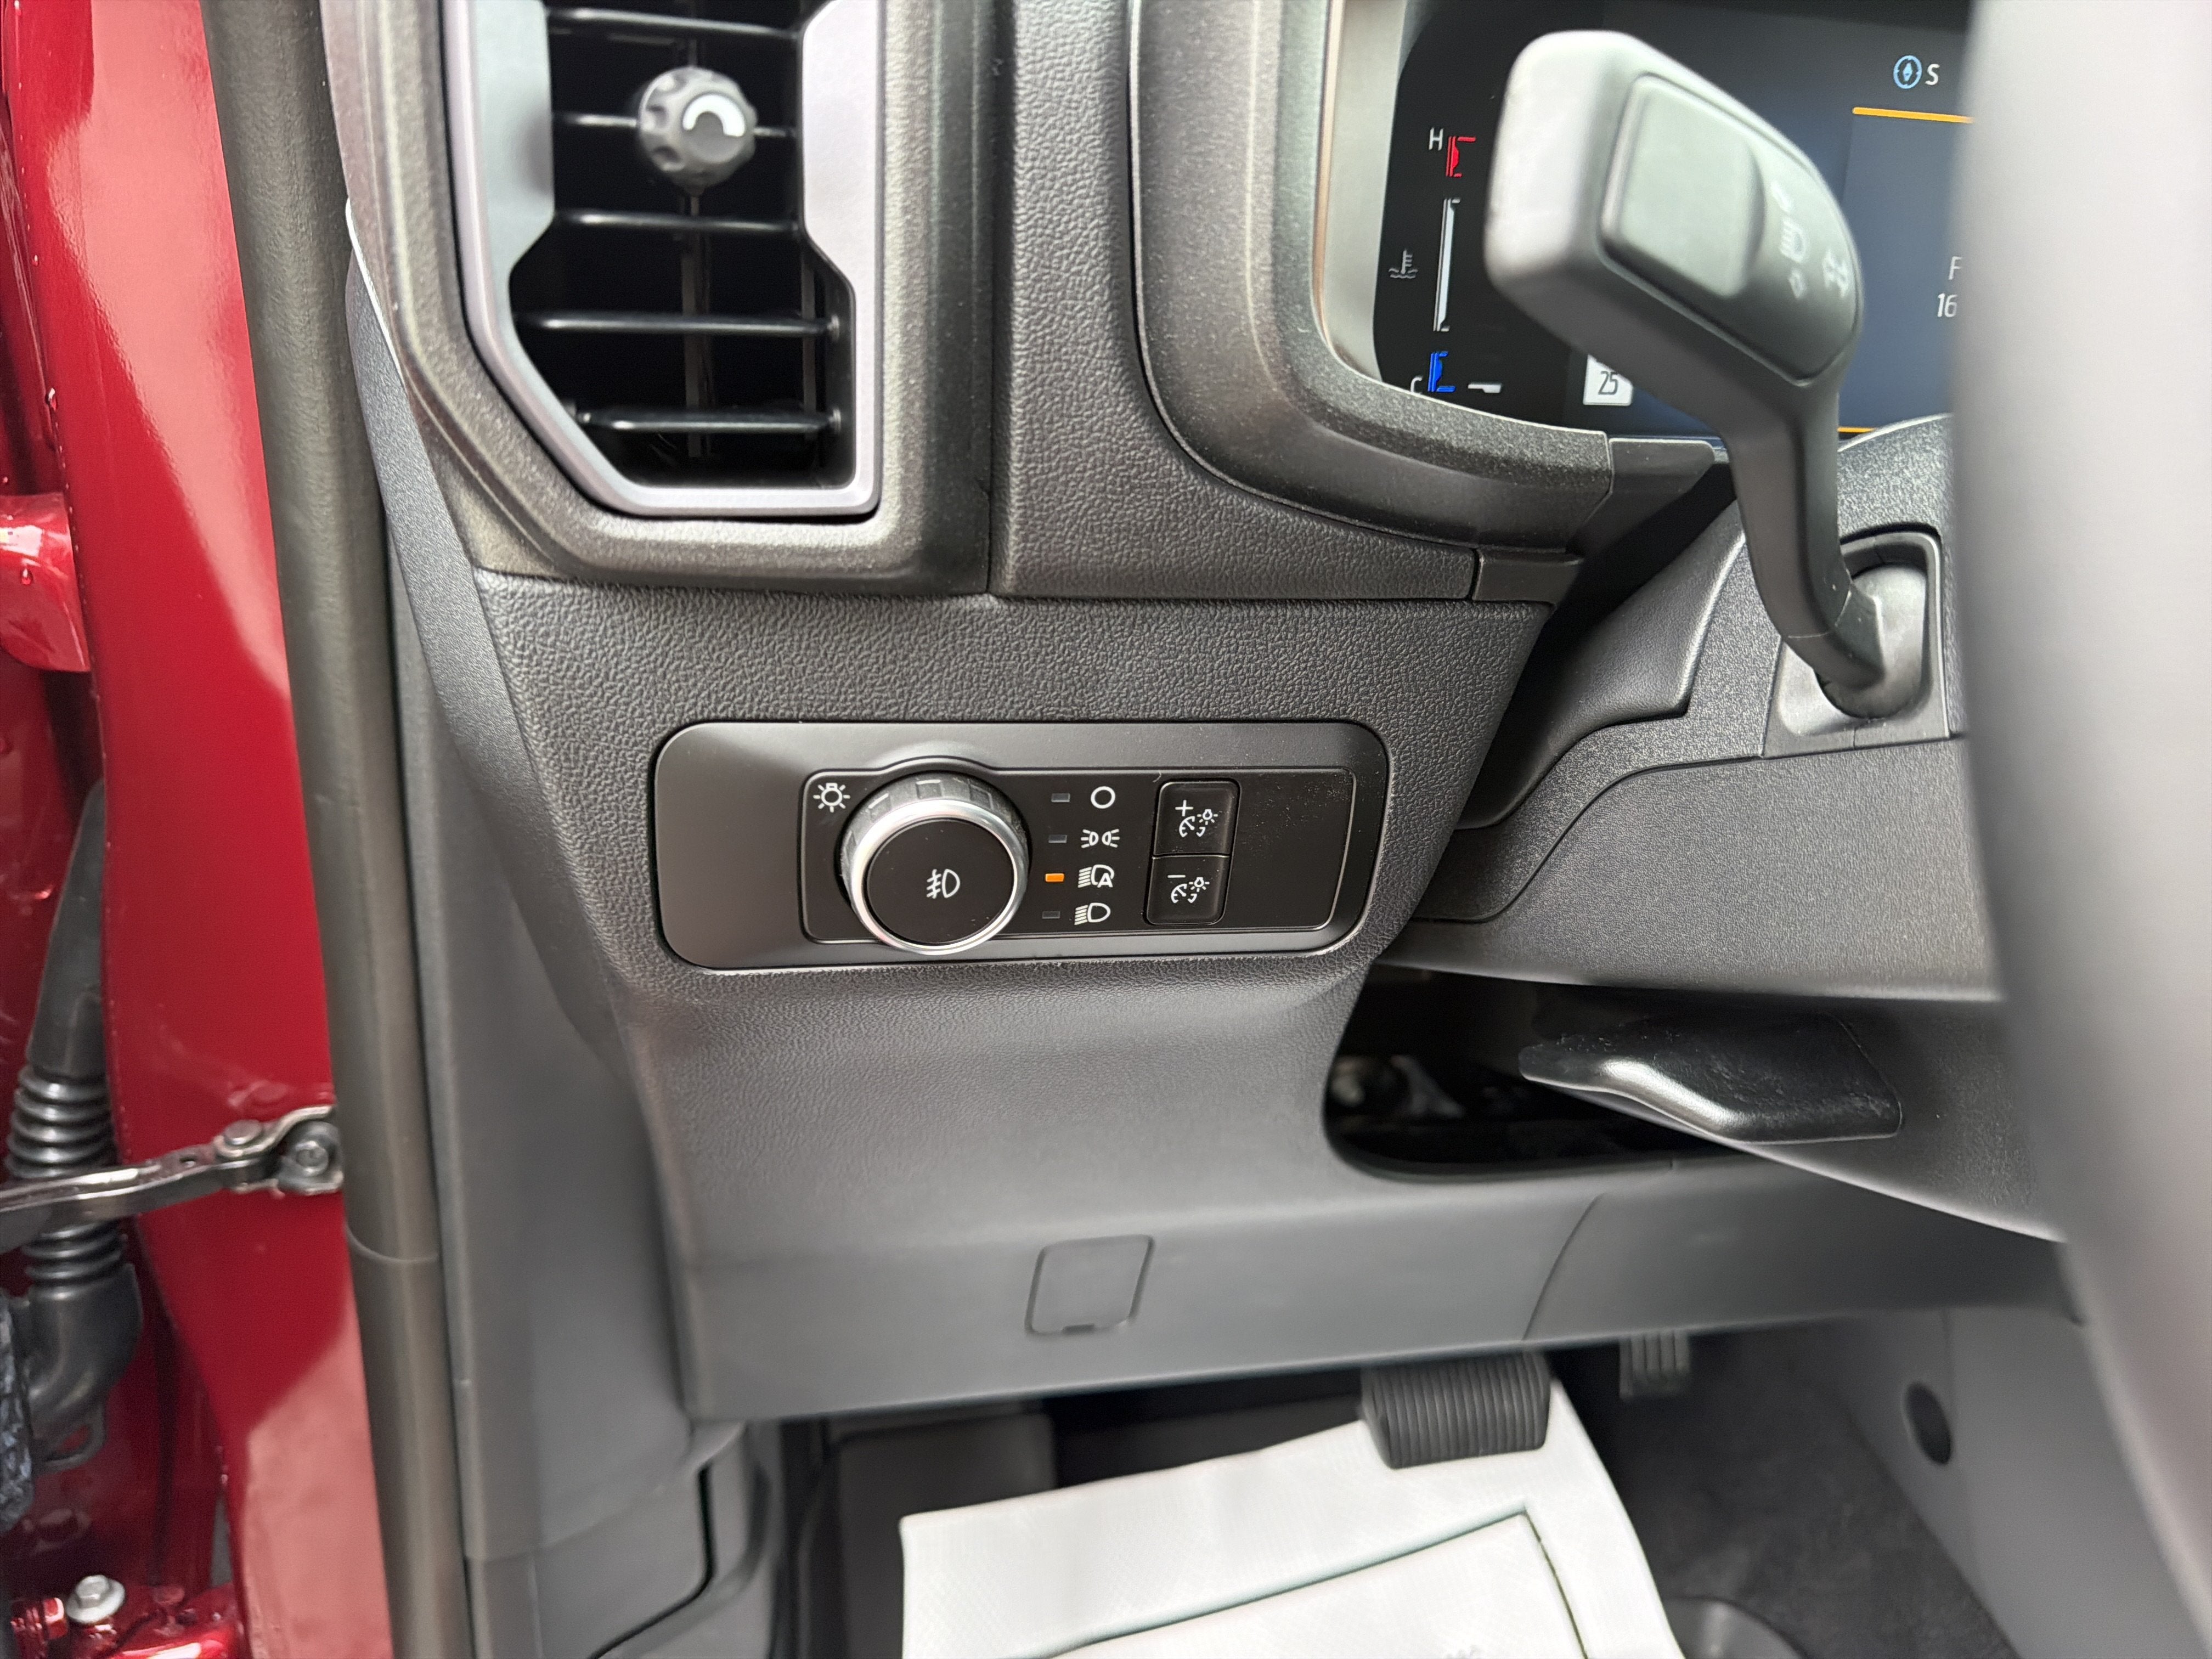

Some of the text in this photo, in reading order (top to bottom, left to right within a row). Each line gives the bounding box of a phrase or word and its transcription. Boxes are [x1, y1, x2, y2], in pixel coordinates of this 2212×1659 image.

[1925, 64, 1940, 86] S
[1429, 127, 1444, 151] H
[1948, 256, 1963, 280] F
[1937, 292, 1958, 318] 16
[1598, 370, 1619, 396] 25
